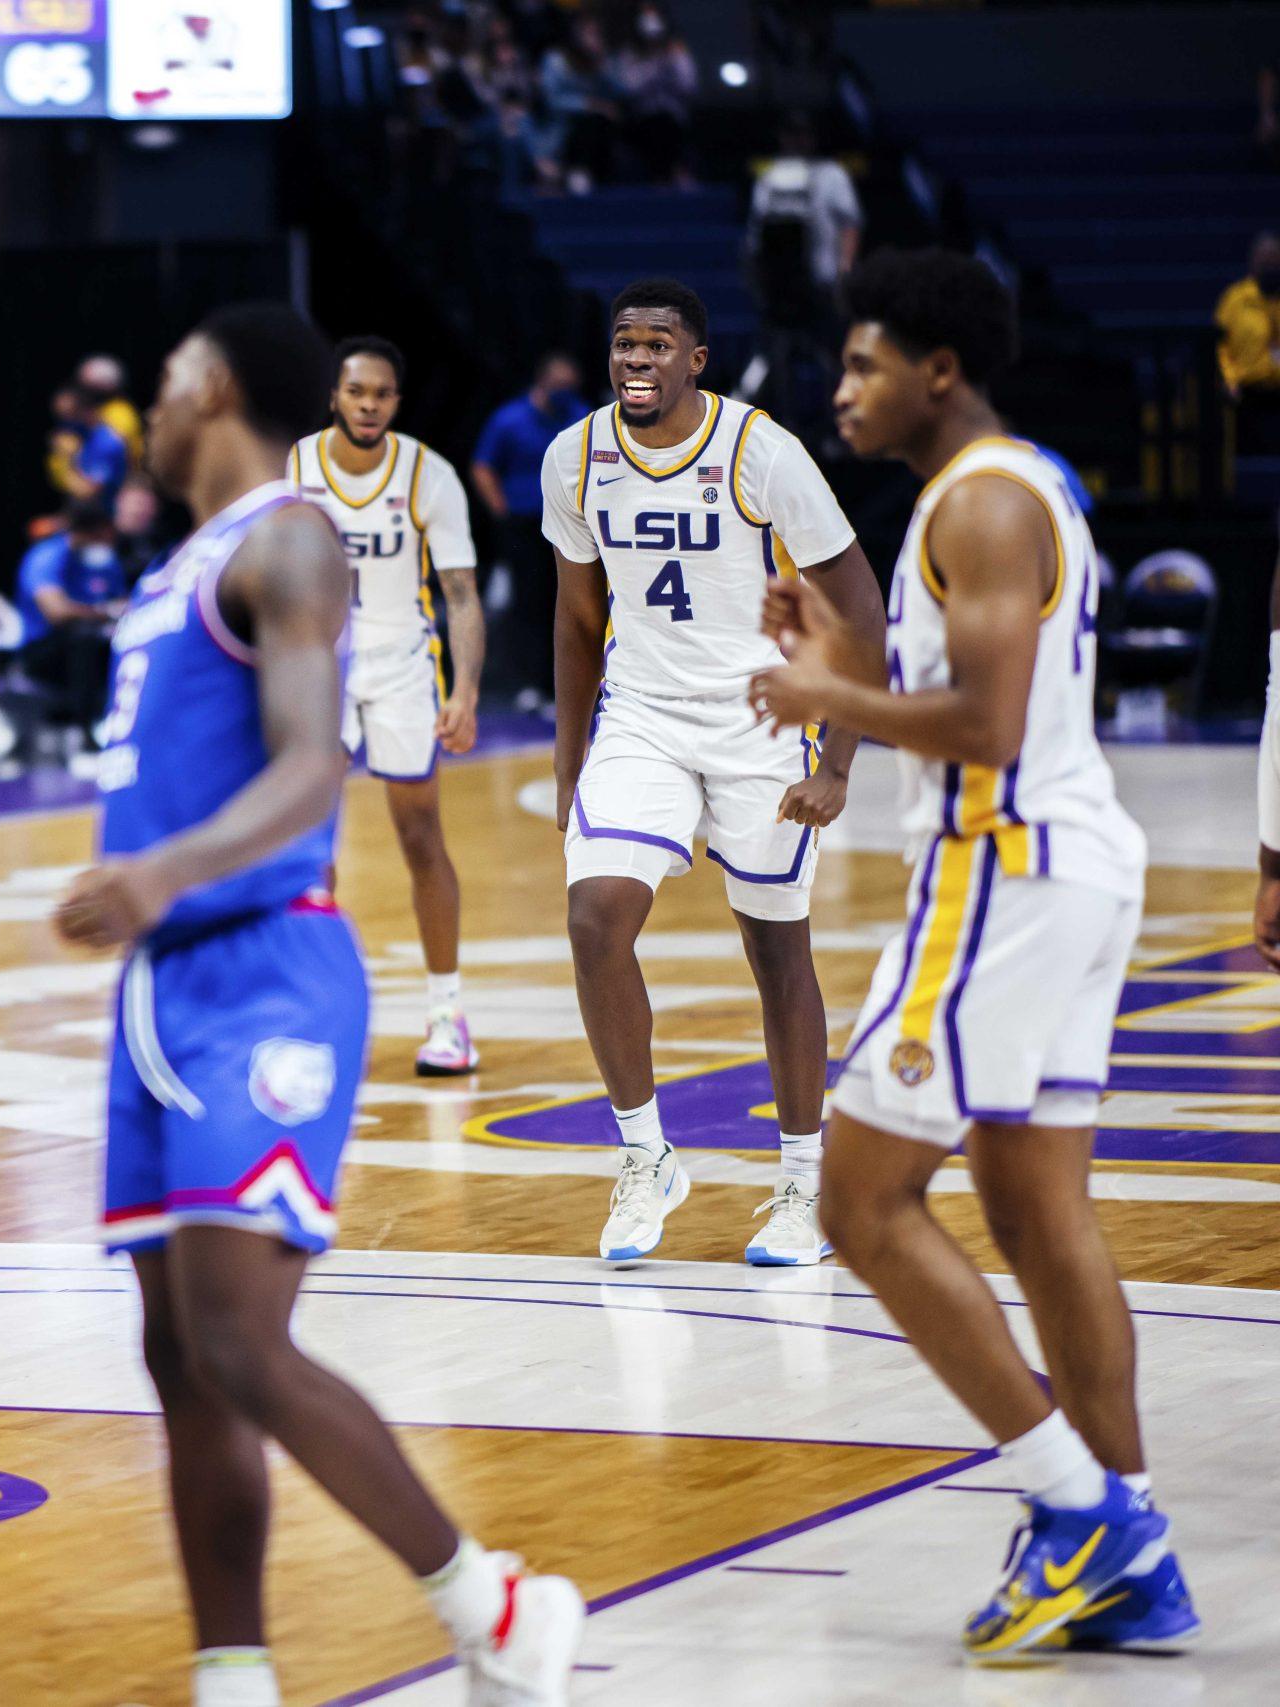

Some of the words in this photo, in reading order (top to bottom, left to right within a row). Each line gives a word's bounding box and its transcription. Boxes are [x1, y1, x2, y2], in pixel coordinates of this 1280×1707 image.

[4, 42, 93, 105] 65
[703, 487, 718, 504] SEC
[339, 530, 404, 558] SU
[596, 509, 721, 552] LSU
[645, 559, 694, 623] 4
